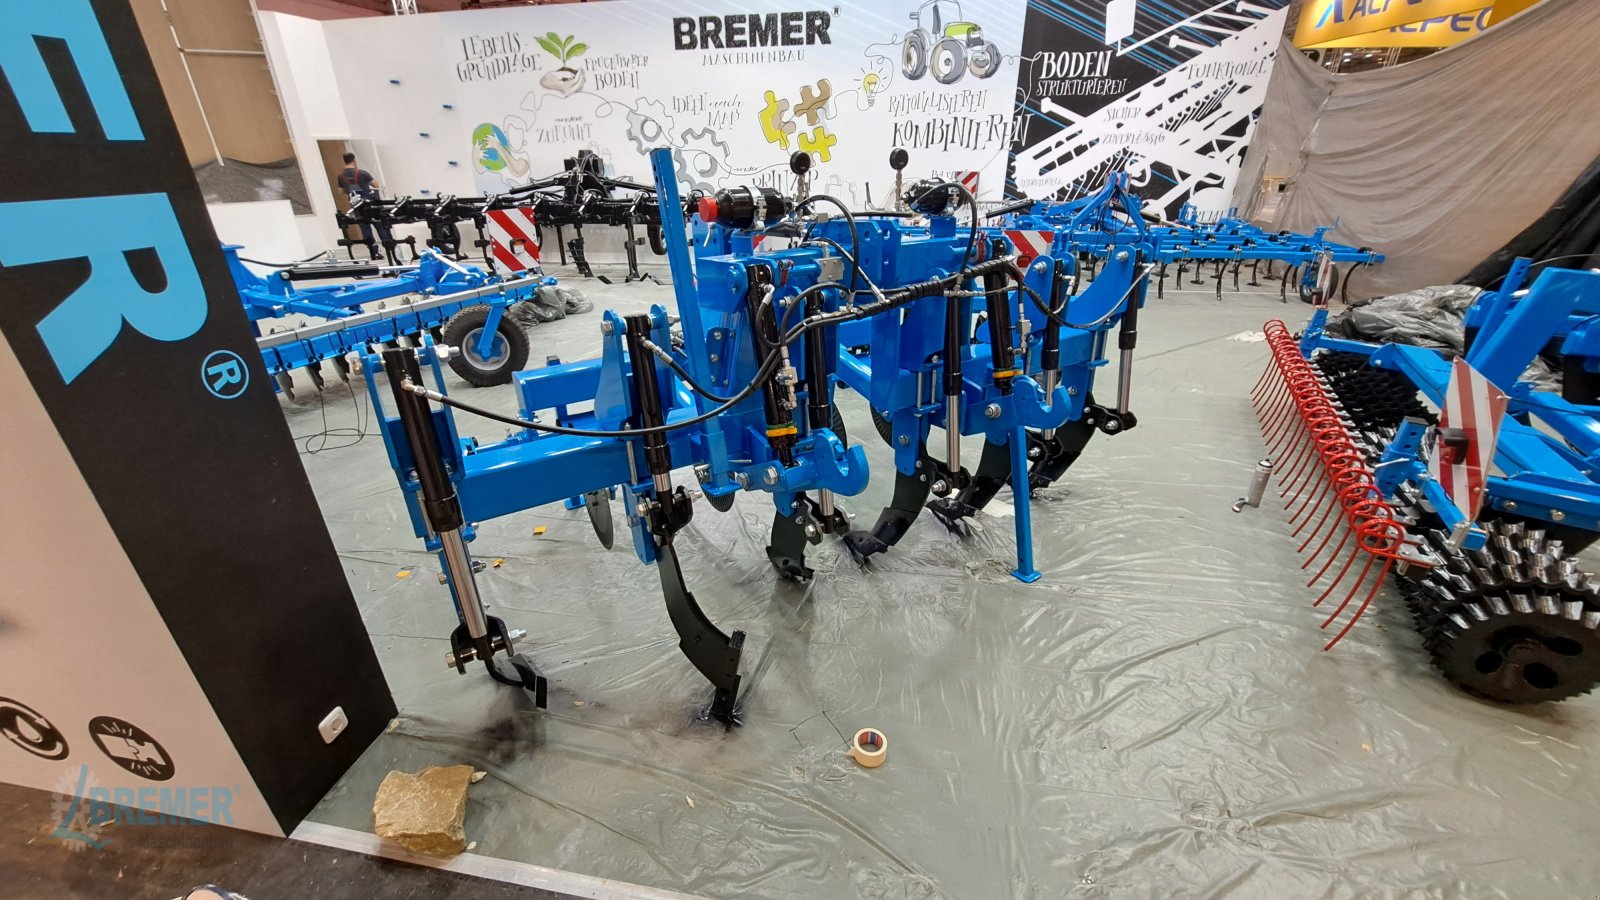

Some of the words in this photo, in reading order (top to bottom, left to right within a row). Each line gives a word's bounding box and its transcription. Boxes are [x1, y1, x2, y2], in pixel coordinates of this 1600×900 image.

[673, 11, 832, 50] BREMER
[456, 52, 543, 82] GRUNDLAGE
[702, 49, 806, 66] MASCHINENBAU
[1038, 50, 1113, 79] BODEN
[595, 71, 640, 90] BODEN
[1036, 78, 1128, 96] STRUKTURIEREN
[672, 92, 708, 115] IDEEN
[709, 94, 743, 108] nach
[888, 89, 990, 117] RATIONALISIEREN
[1104, 106, 1142, 122] SICHER
[536, 122, 593, 143] ZUKUNFT
[892, 113, 1035, 152] KOMBINIEREN
